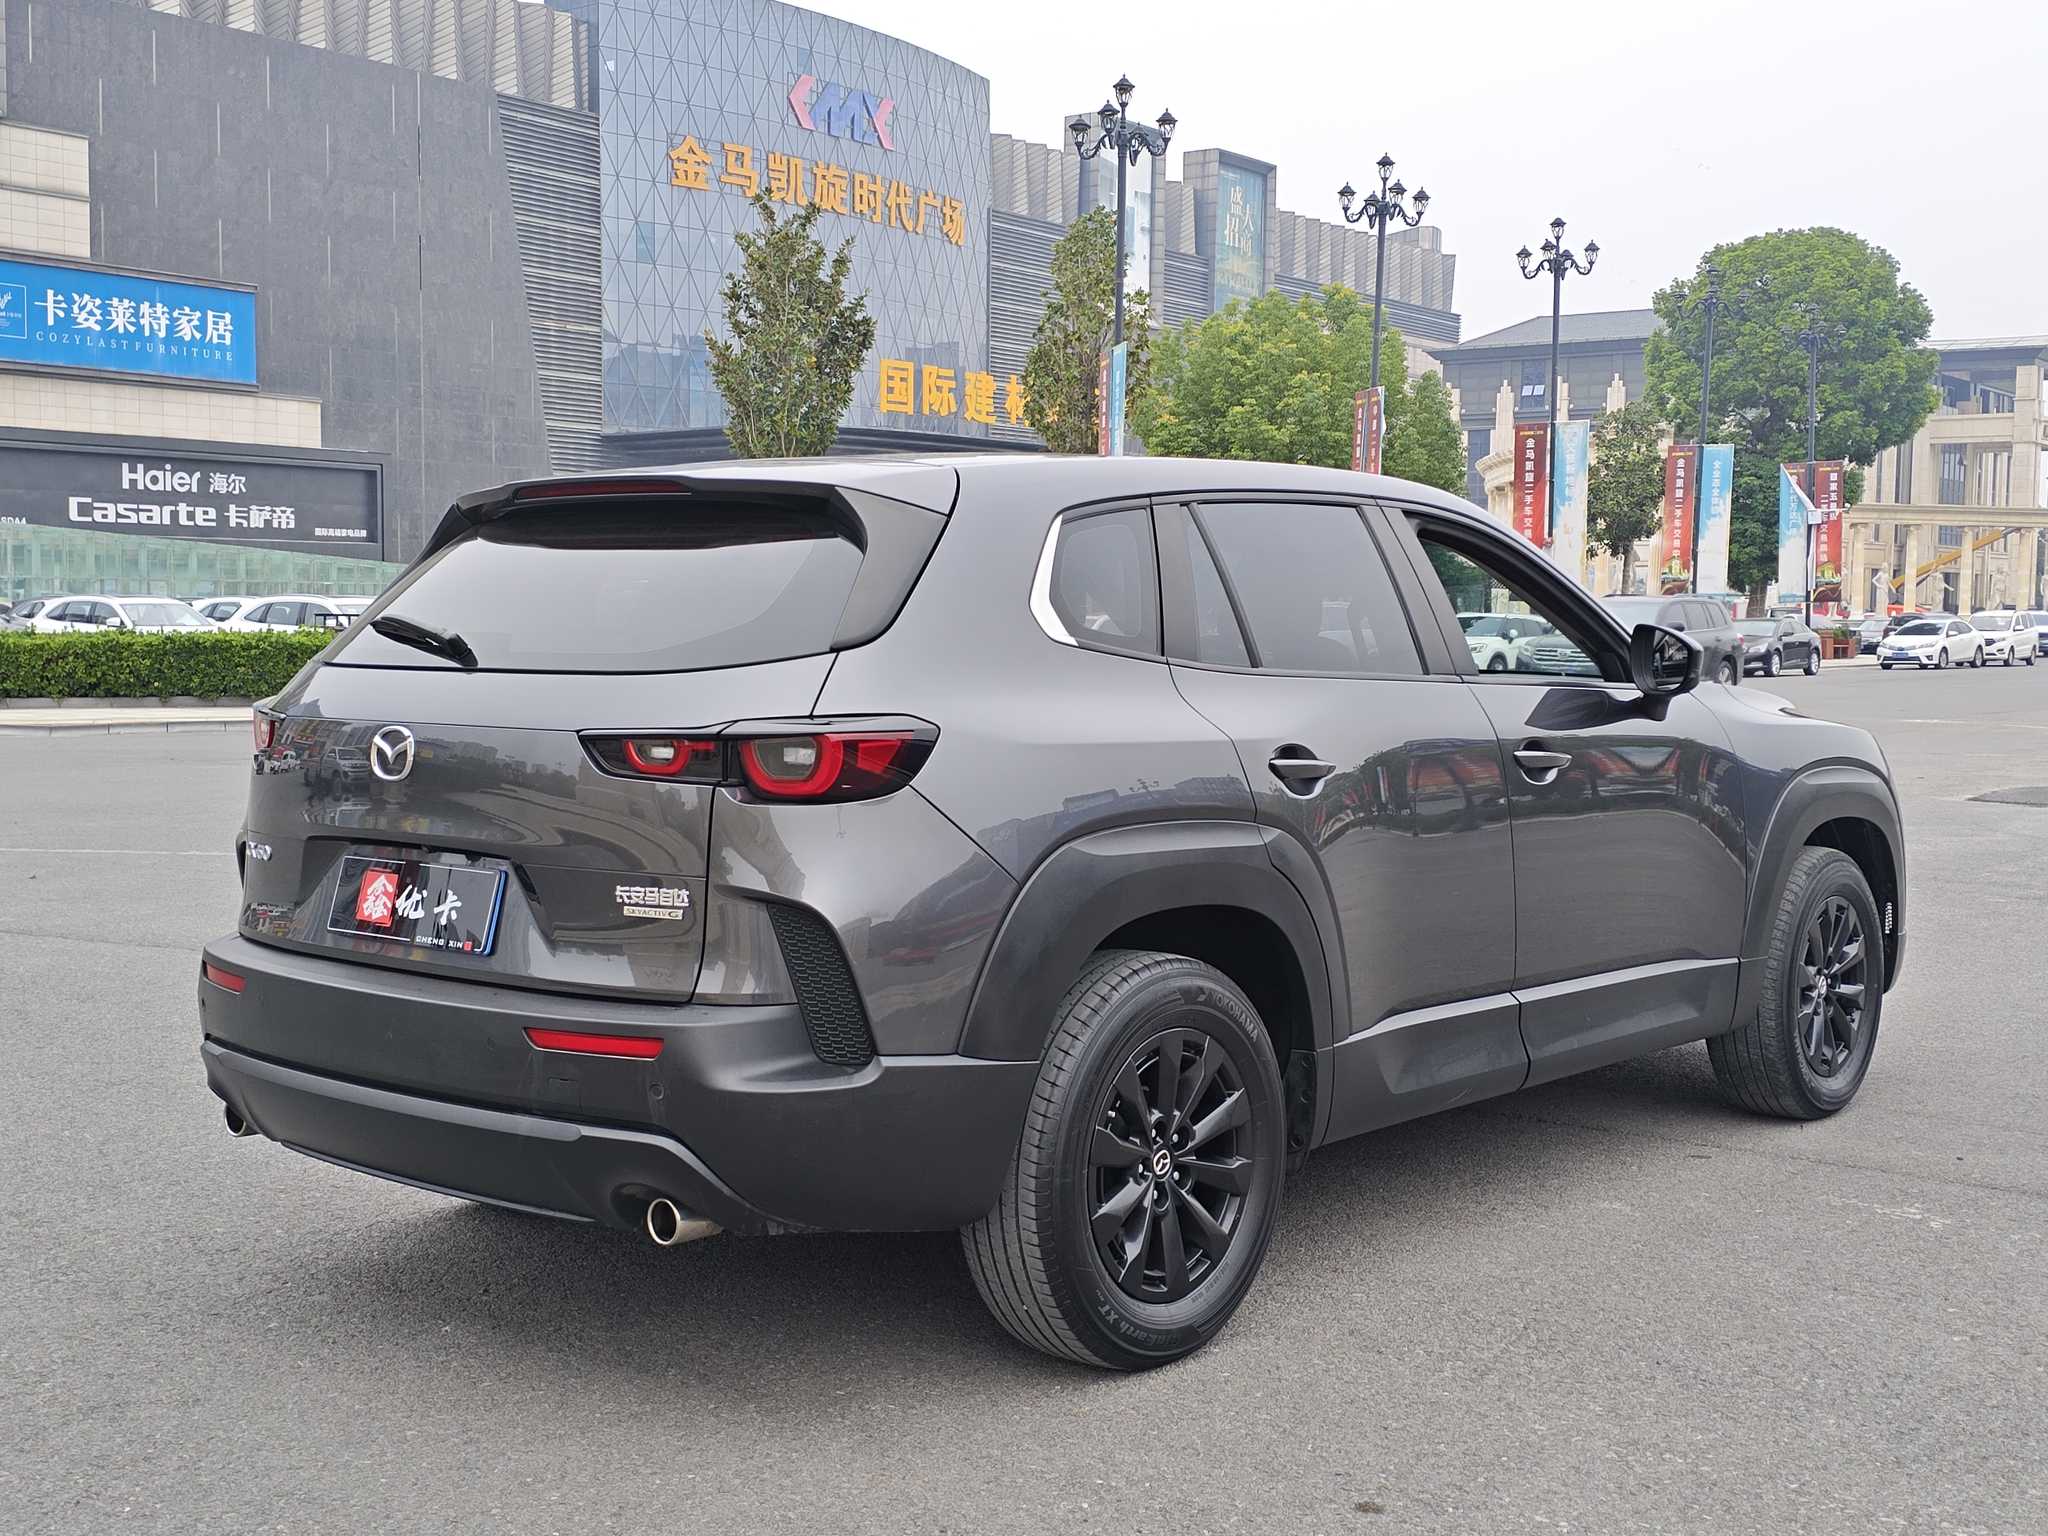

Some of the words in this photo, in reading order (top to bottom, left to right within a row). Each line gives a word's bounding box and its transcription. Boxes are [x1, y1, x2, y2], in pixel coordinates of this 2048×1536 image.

[668, 134, 966, 246] 金马凯旋时代广场
[34, 289, 234, 346] 卡姿莱特家居
[135, 340, 233, 361] FURNITURE
[121, 463, 200, 493] Haier
[208, 472, 247, 496] 海尔
[68, 496, 217, 527] Casarte
[224, 503, 296, 530] 卡萨帝
[615, 885, 690, 907] 长安马自达
[415, 935, 445, 946] CHENG
[448, 940, 463, 949] XIN
[1210, 989, 1258, 1042] YOKOHAMA
